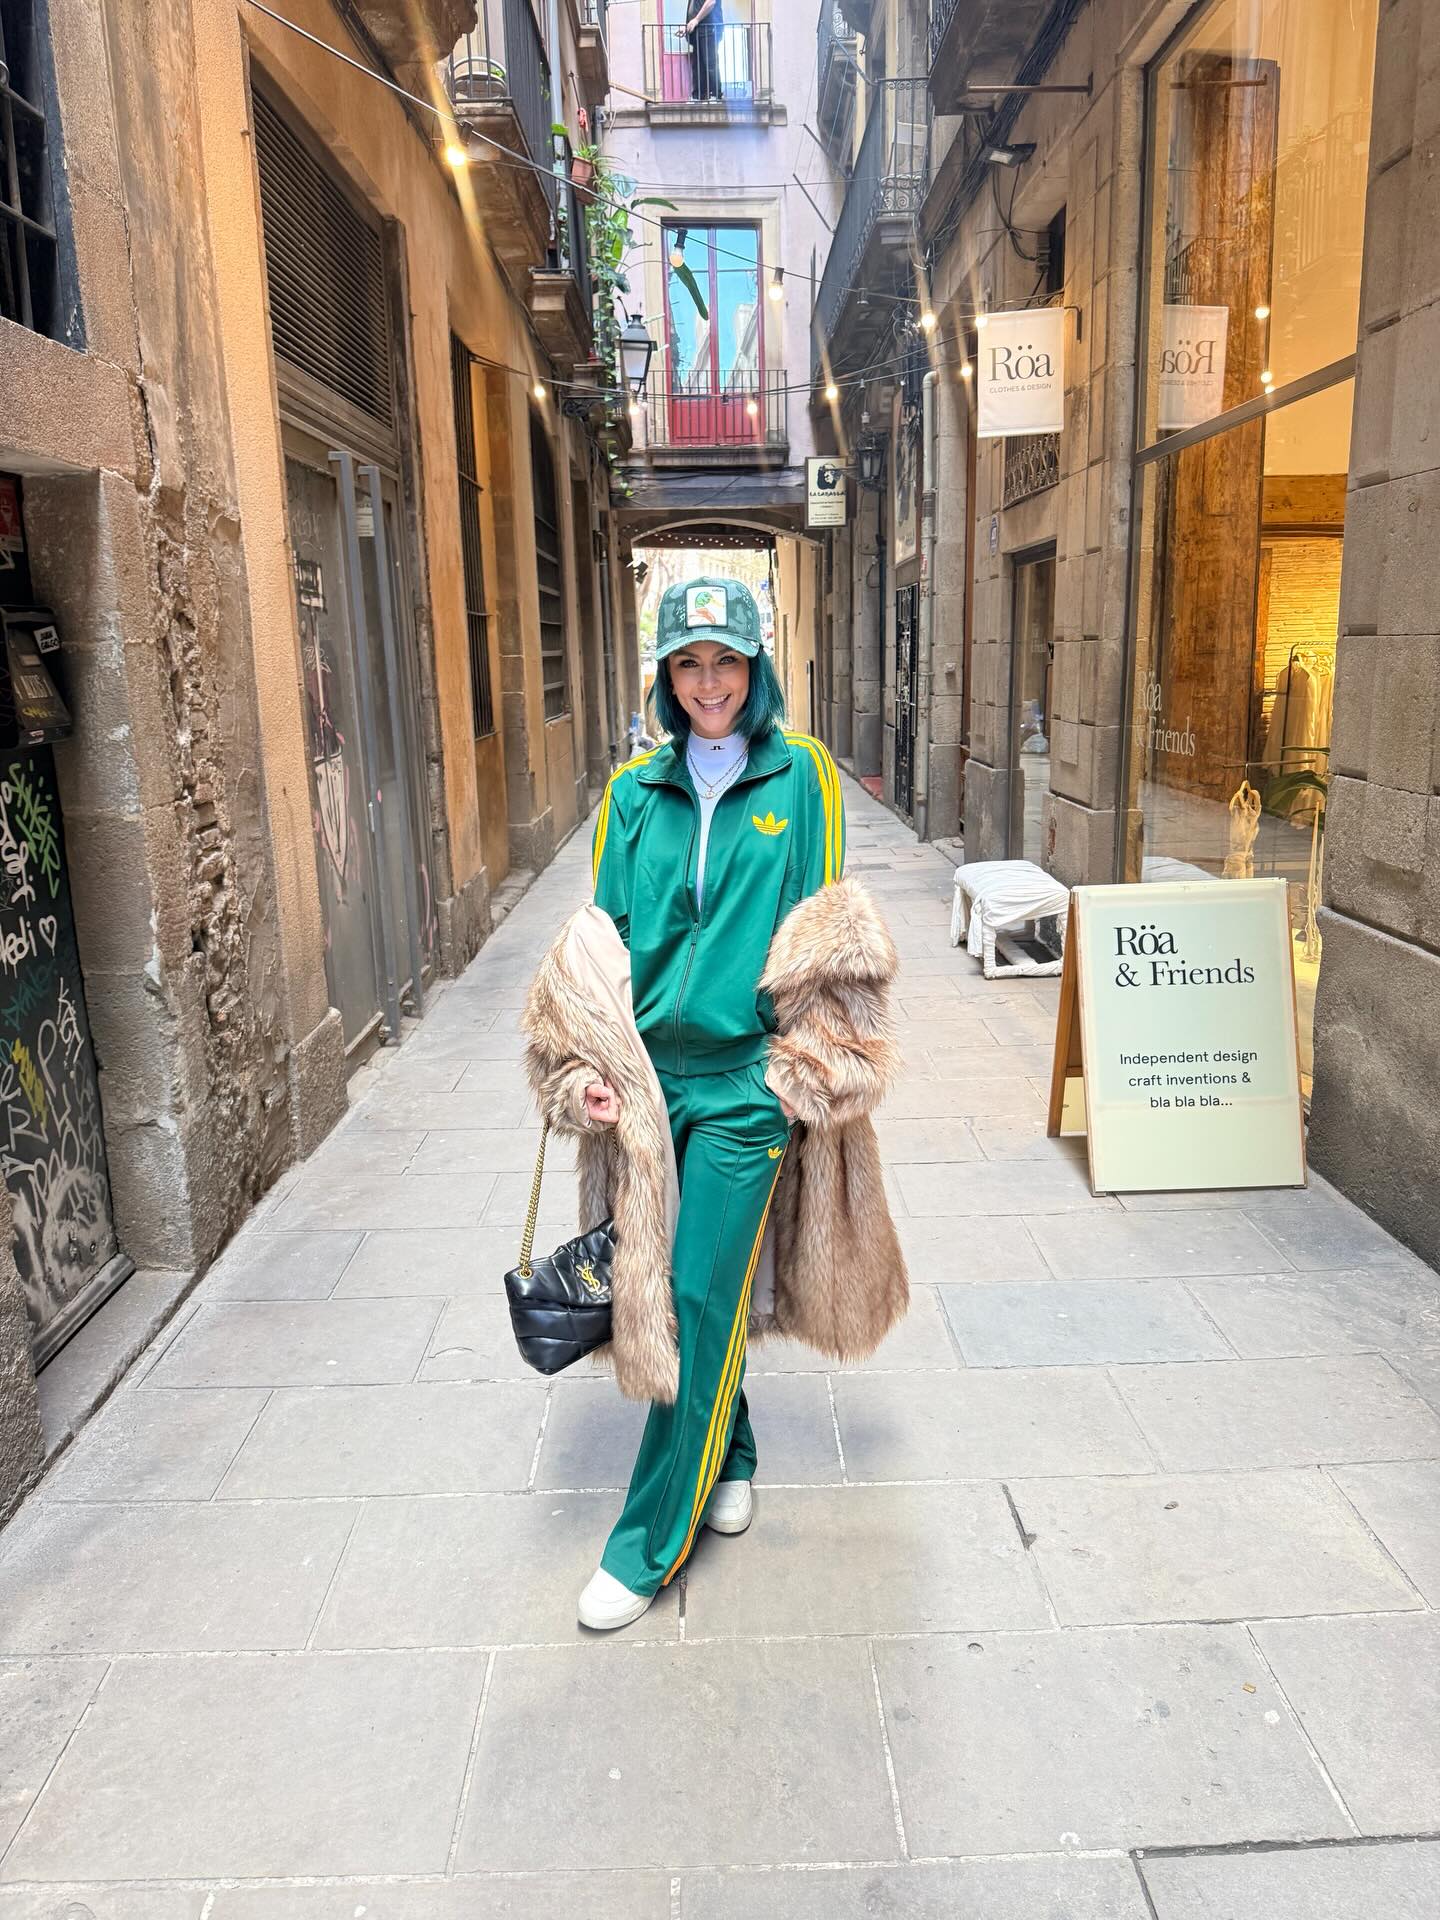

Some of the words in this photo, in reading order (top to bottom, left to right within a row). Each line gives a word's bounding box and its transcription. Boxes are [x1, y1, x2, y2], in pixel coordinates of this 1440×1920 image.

[988, 344, 1055, 381] Röa
[989, 385, 1020, 394] CLOTHES
[1026, 383, 1052, 391] DESIGN
[1148, 715, 1196, 757] Friends
[1113, 924, 1179, 956] Röa
[1115, 962, 1141, 988] &
[1149, 958, 1255, 987] Friends
[1119, 1052, 1209, 1067] Independent
[1212, 1050, 1258, 1065] design
[1128, 1074, 1162, 1087] craft
[1166, 1072, 1237, 1086] inventions
[1241, 1071, 1252, 1084] &
[1149, 1096, 1170, 1109] bla
[1174, 1095, 1196, 1108] bla
[1199, 1095, 1233, 1107] bla...
